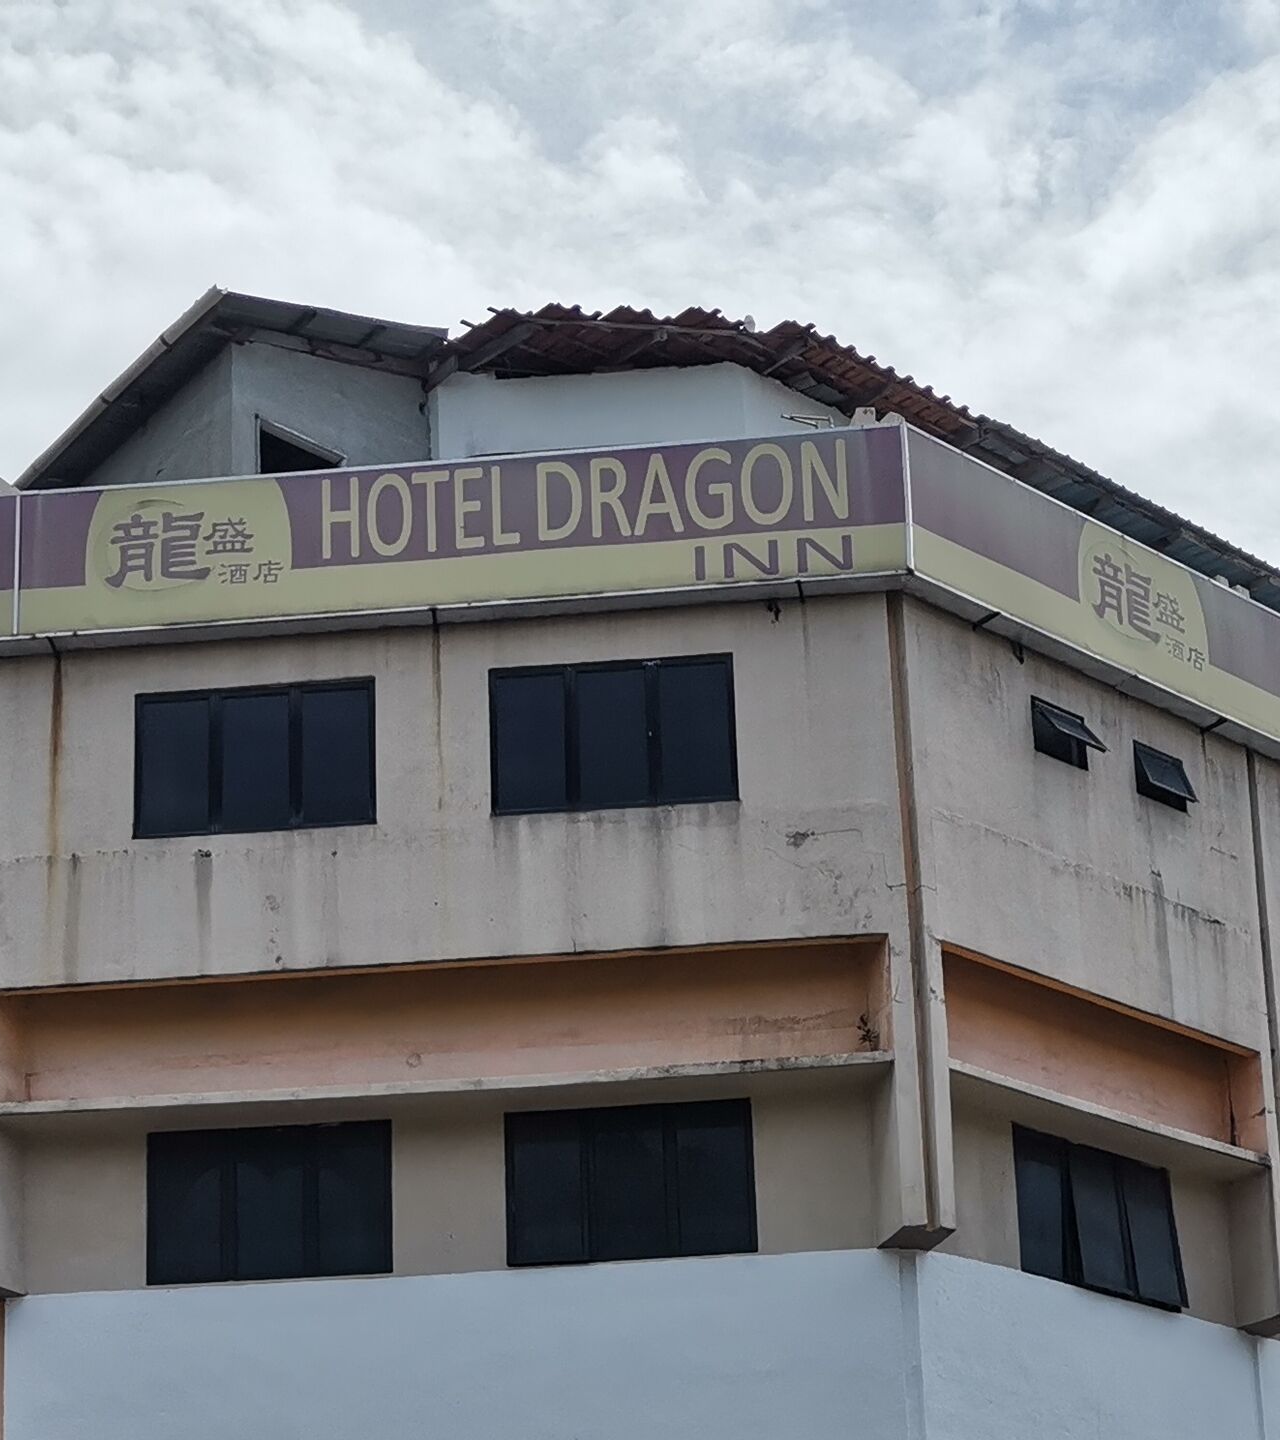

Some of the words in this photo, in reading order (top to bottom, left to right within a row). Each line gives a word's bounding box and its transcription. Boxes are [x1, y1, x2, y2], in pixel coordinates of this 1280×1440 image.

[322, 465, 520, 560] HOTEL
[536, 438, 849, 541] DRAGON
[693, 533, 855, 581] INN
